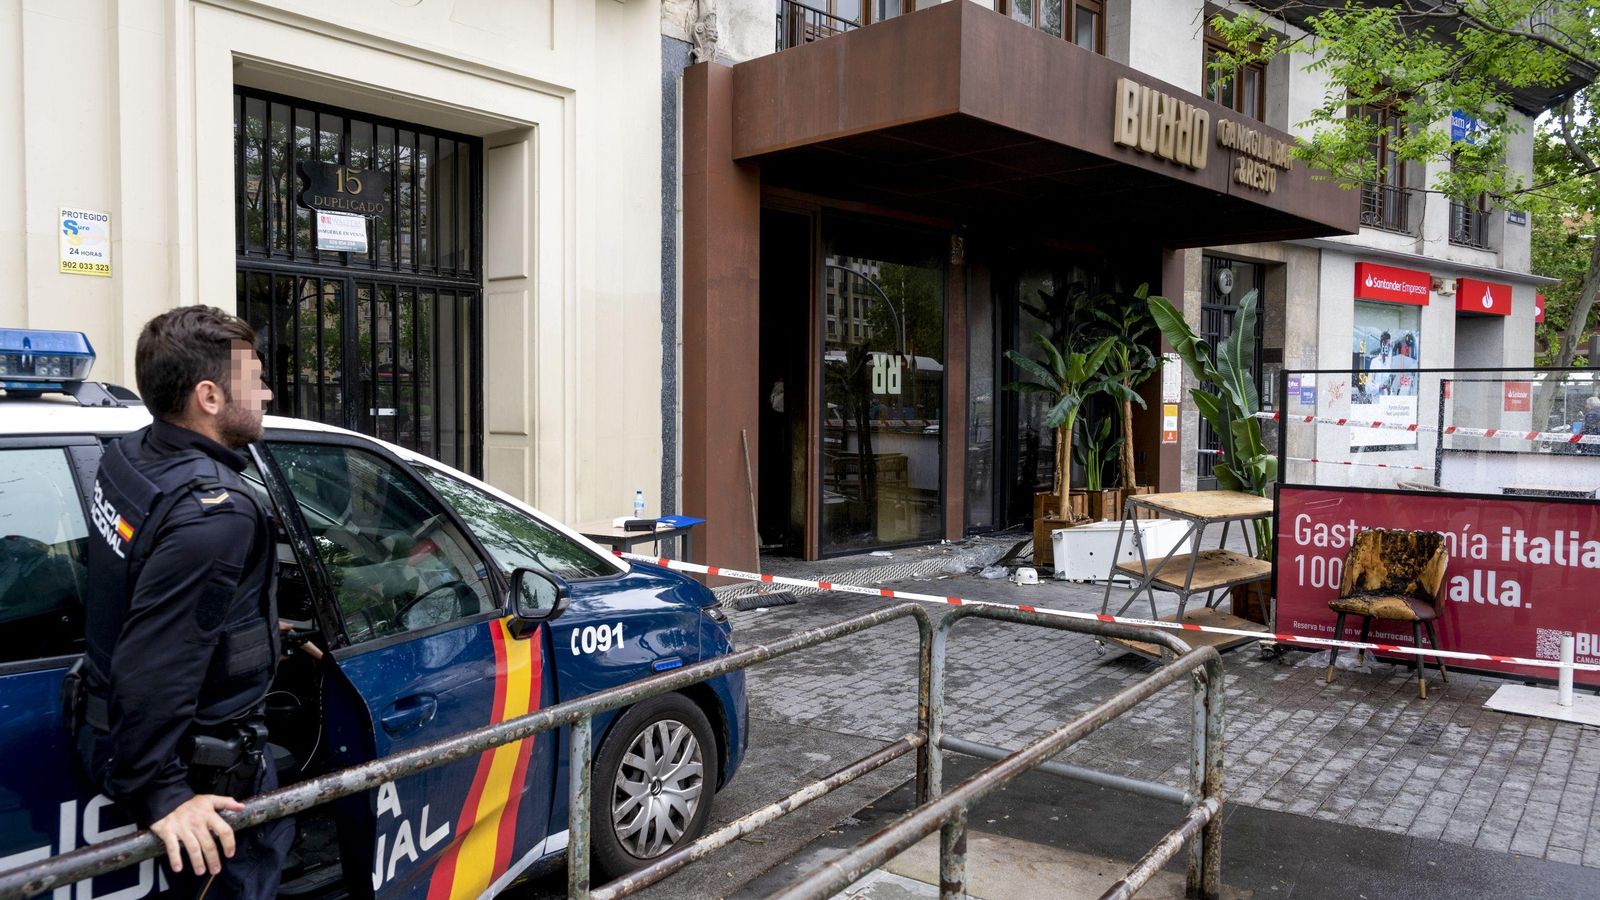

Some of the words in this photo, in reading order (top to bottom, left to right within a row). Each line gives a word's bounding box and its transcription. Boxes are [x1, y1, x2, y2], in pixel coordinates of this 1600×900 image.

[1114, 78, 1210, 170] BURRO
[1217, 118, 1272, 163] CANAGLIA
[336, 166, 363, 195] 15
[314, 195, 384, 213] DUPLICADO
[61, 210, 108, 222] PROTEGIDO
[69, 247, 80, 255] 24
[81, 250, 103, 258] HORAS
[62, 260, 77, 269] 902
[79, 262, 94, 270] 033
[95, 264, 110, 272] 323
[1373, 277, 1402, 292] Santander
[1402, 282, 1427, 295] Empresas
[1293, 620, 1318, 631] Reserva
[1318, 624, 1326, 632] tu
[581, 621, 625, 655] 091
